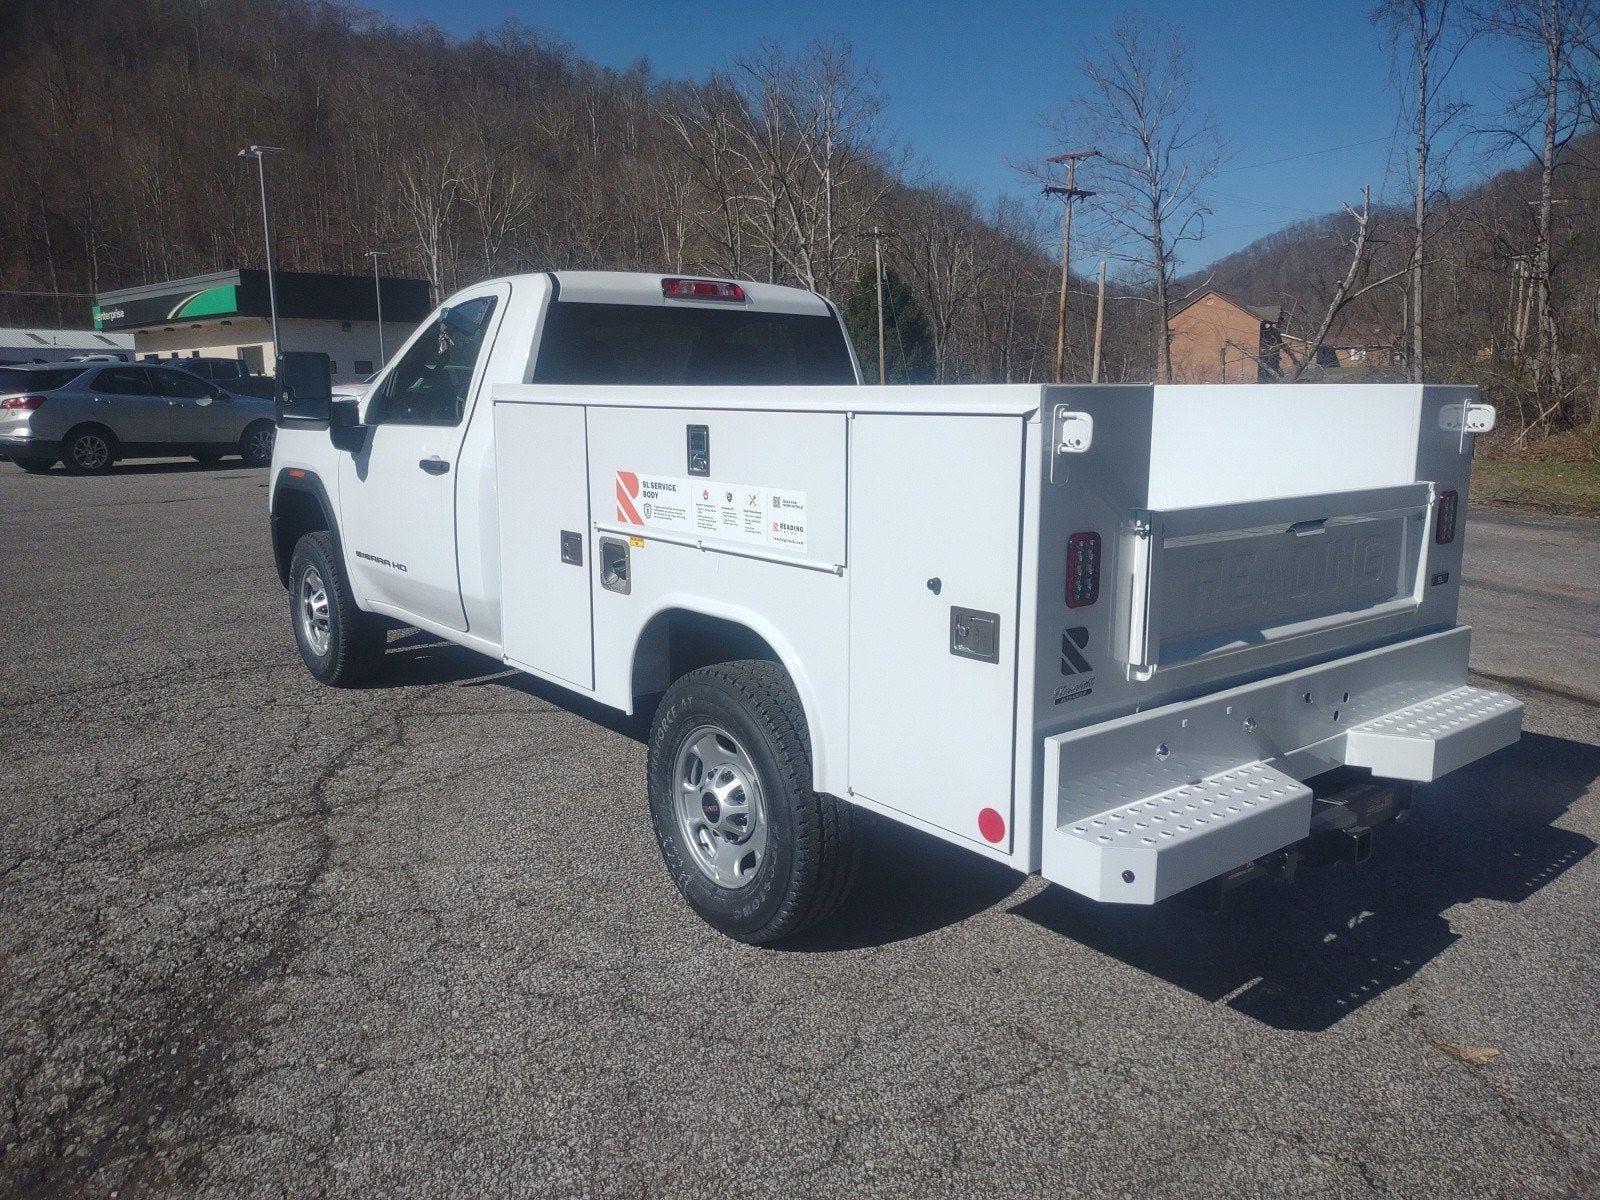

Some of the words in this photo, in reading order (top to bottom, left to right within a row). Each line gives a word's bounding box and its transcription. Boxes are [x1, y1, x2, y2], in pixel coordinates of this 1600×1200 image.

[96, 308, 125, 322] enterprise
[650, 481, 677, 492] SERVICE
[642, 490, 659, 499] BODY
[779, 523, 804, 533] READING
[355, 550, 392, 567] SIERRA
[392, 561, 408, 573] HD
